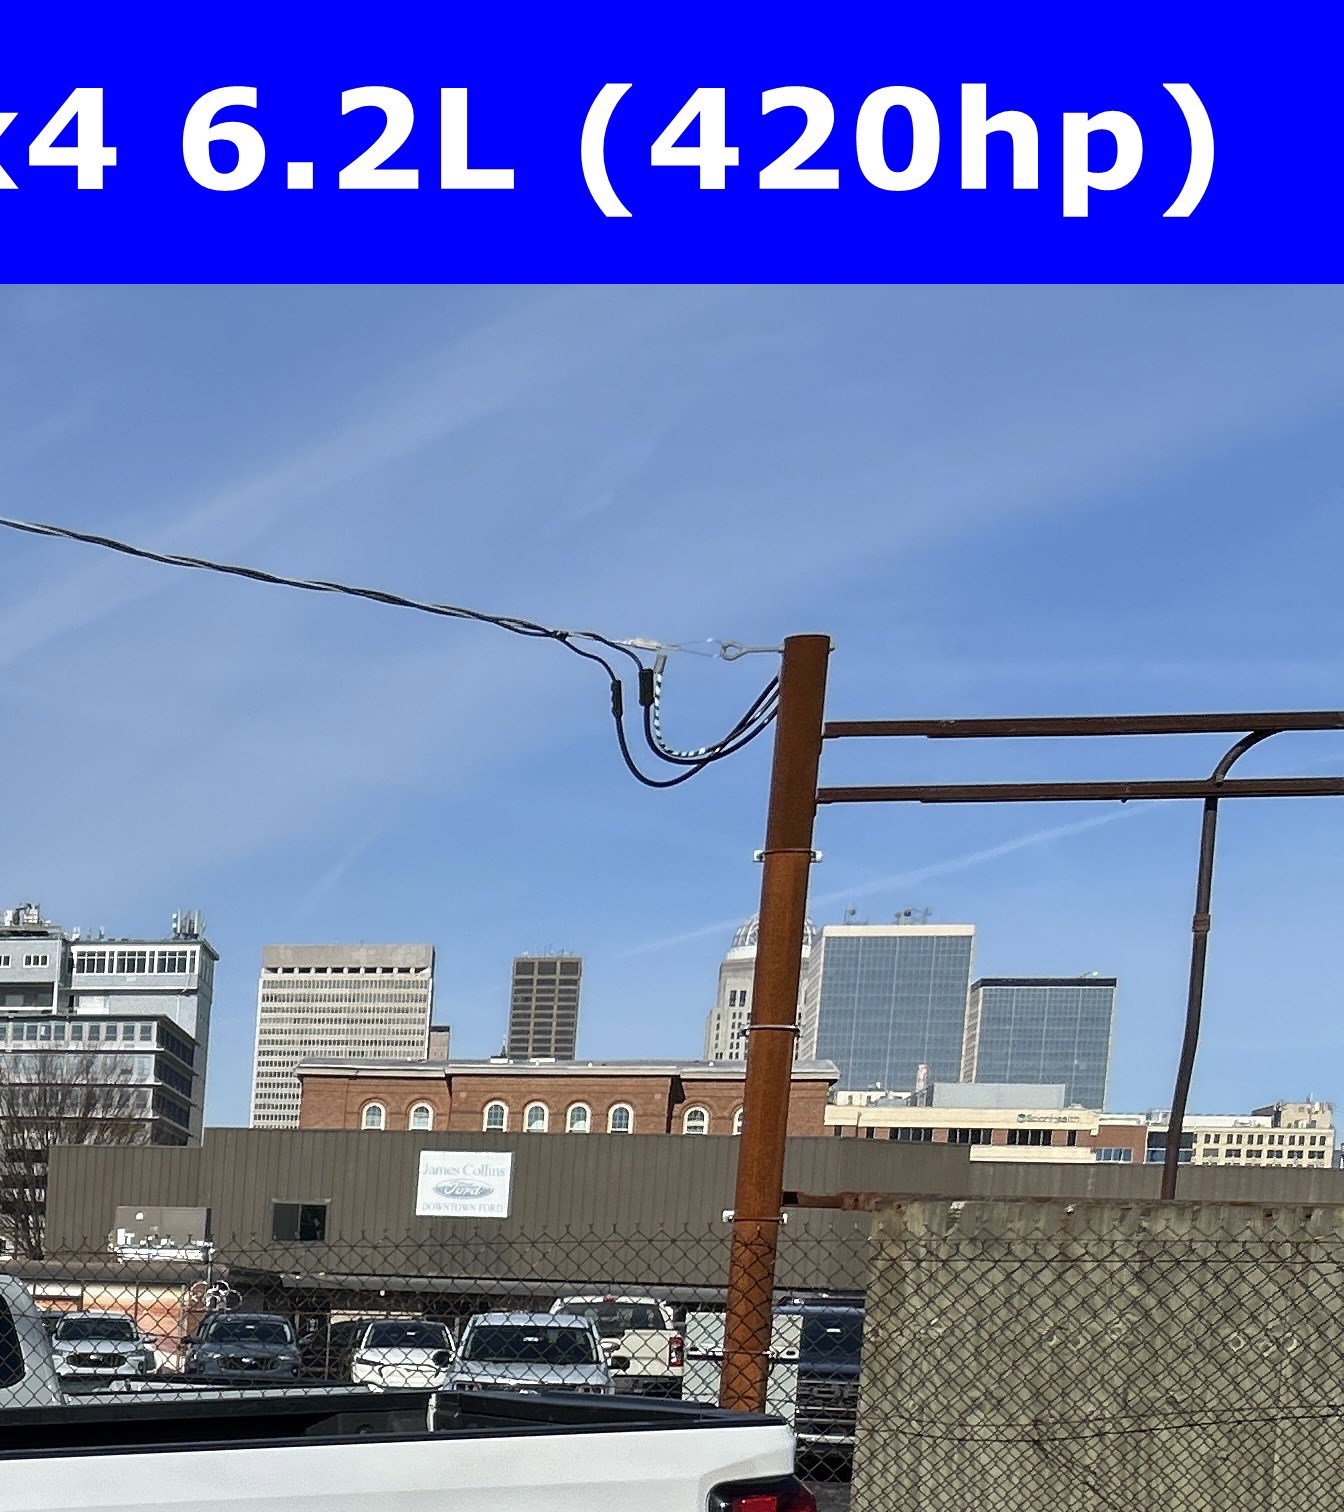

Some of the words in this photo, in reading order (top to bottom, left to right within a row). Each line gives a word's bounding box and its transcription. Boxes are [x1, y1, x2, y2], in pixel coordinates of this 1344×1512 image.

[422, 1163, 461, 1177] James
[462, 1162, 506, 1178] Collins
[443, 1180, 483, 1197] Ford
[422, 1202, 476, 1213] DOWNTOWN
[478, 1203, 503, 1214] FORD
